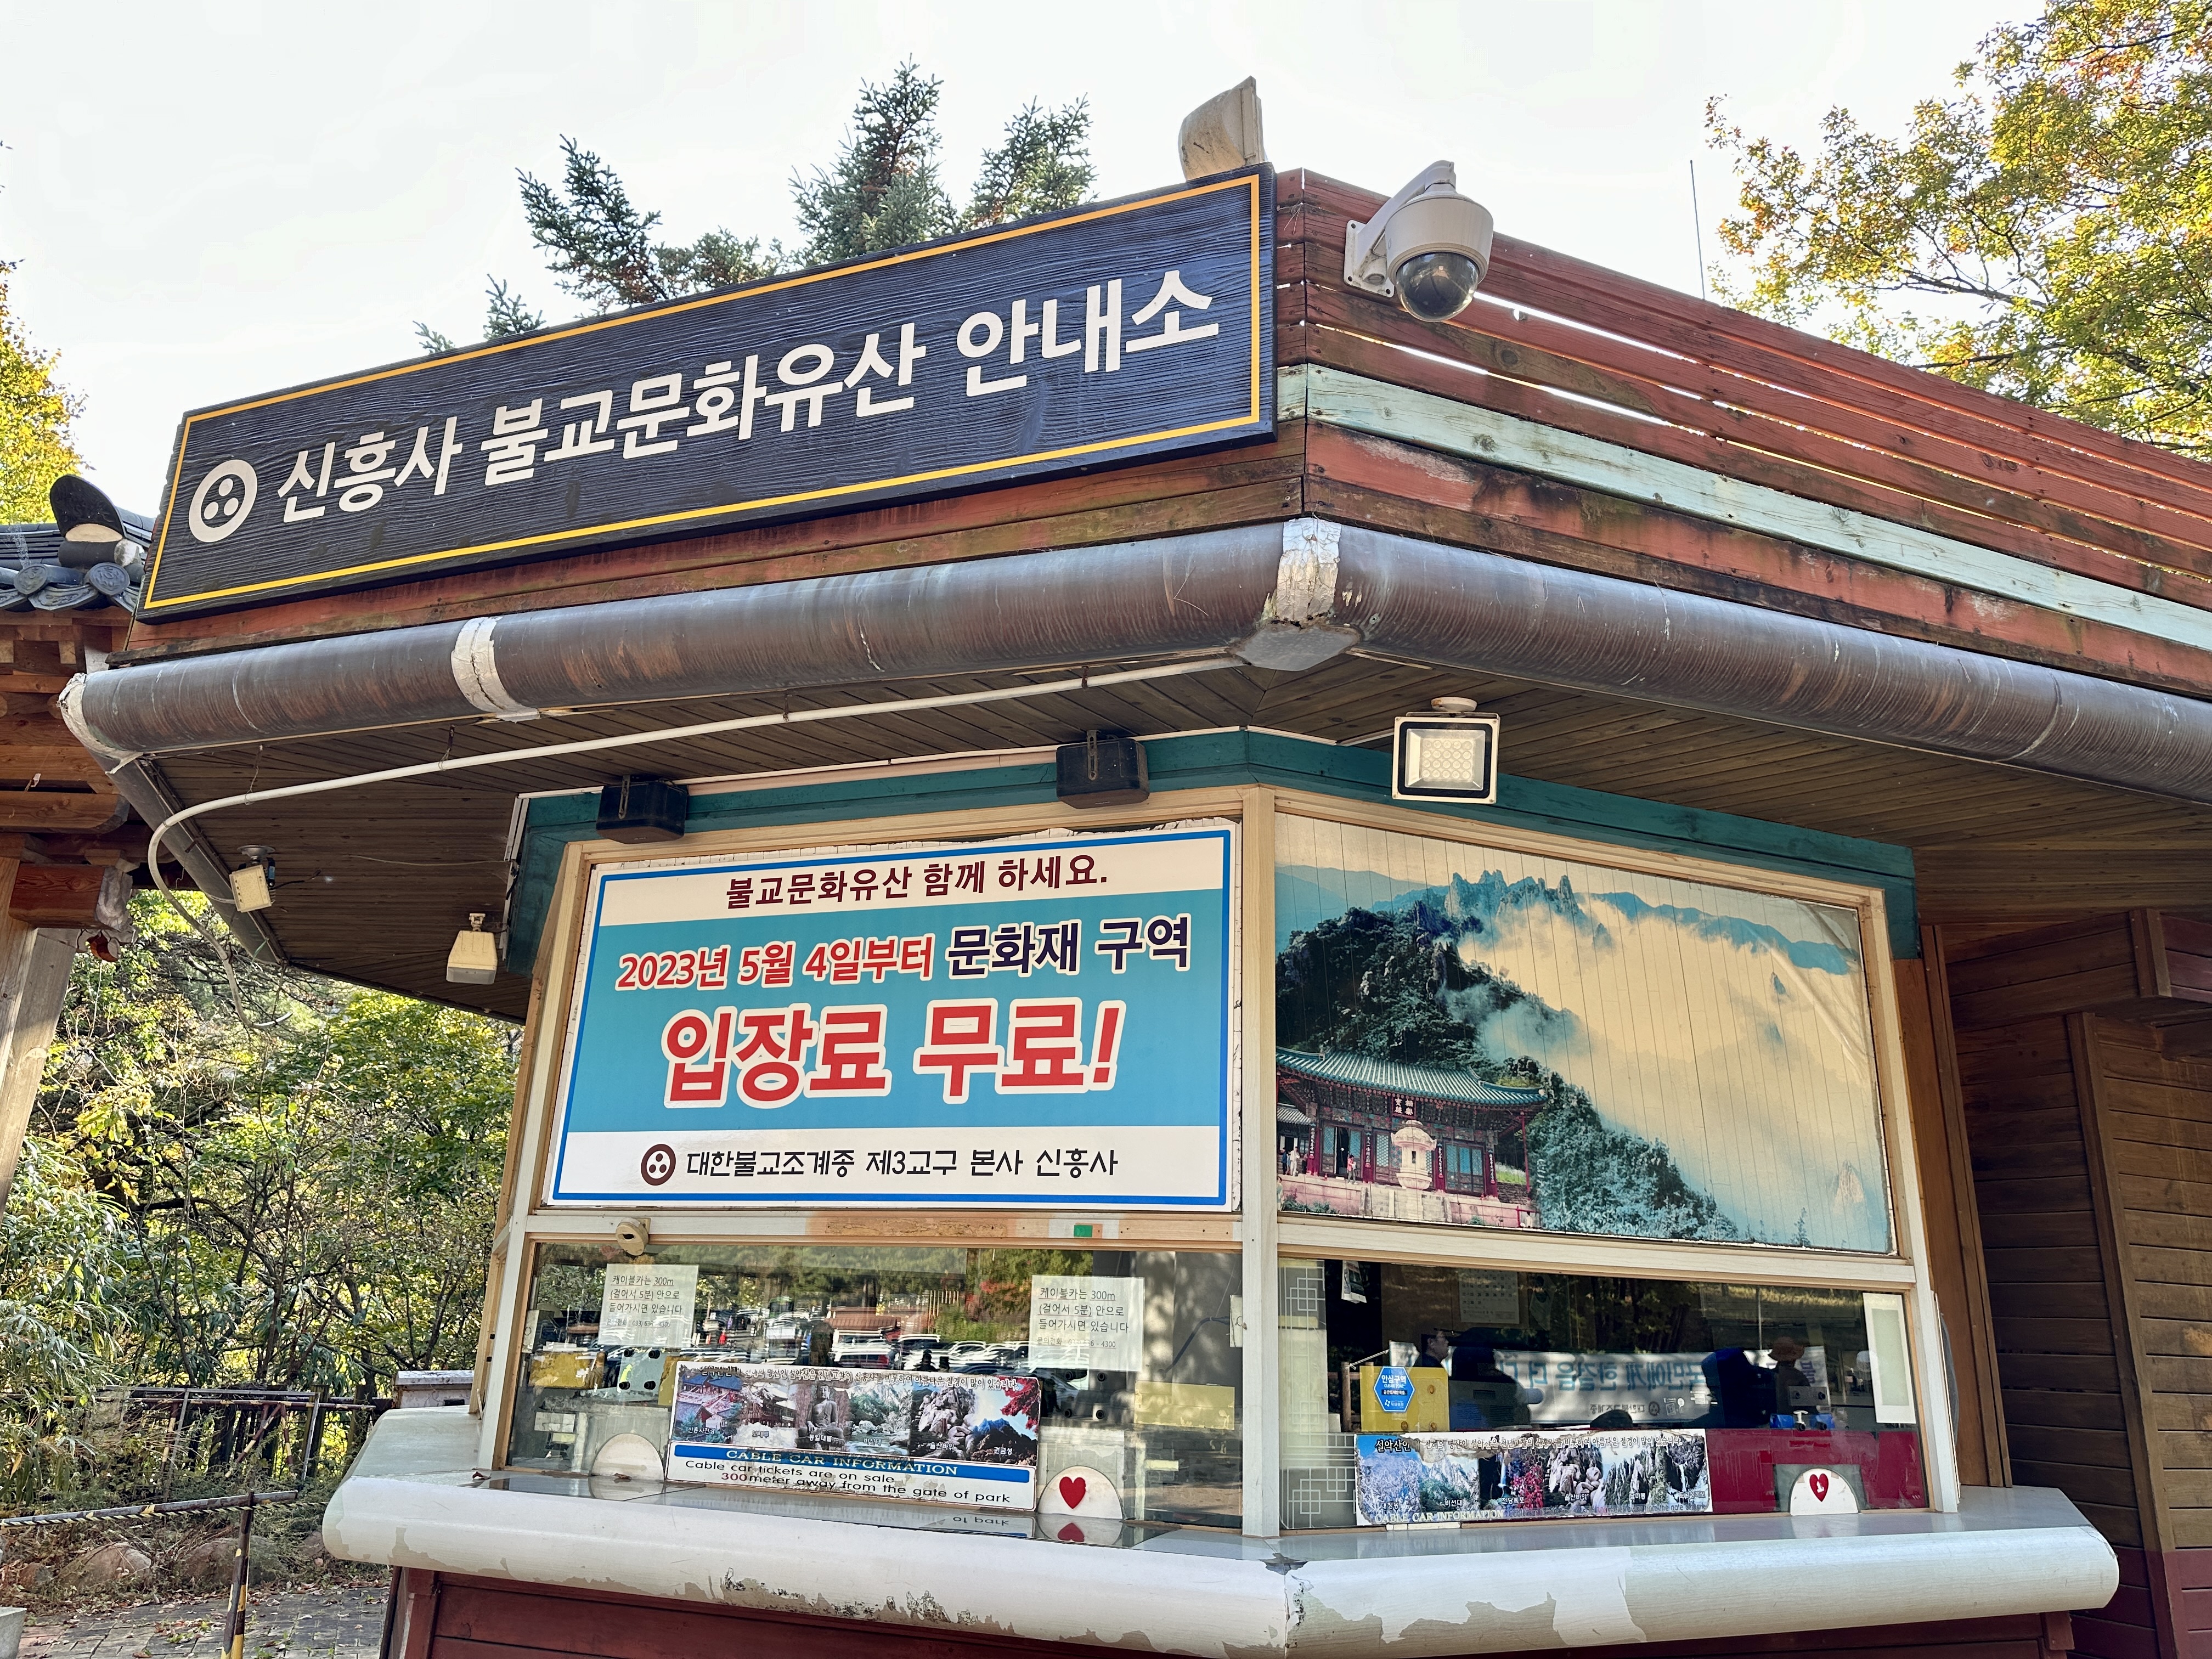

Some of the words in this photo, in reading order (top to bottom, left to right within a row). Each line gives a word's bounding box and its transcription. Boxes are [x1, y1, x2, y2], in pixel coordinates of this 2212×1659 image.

[277, 416, 462, 523] 신흥사
[481, 323, 926, 486] 불교문화유산
[957, 269, 1219, 397] 안내소
[726, 866, 912, 910] 불교문화유산
[923, 861, 985, 897] 함께
[998, 854, 1108, 891] 하세요.
[616, 945, 731, 990] 2023년
[740, 943, 794, 986] 5월
[805, 936, 932, 983] 4일부터
[947, 922, 1080, 977] 문화재
[1097, 916, 1188, 969] 구역
[666, 1009, 887, 1102] 입장료
[918, 1003, 1120, 1097] 무료!
[686, 1149, 855, 1178] 대한불교조계종
[866, 1149, 957, 1176] 제3교구
[970, 1149, 1024, 1176] 본사
[1036, 1148, 1119, 1179] 신흥사
[611, 1275, 652, 1285] 케이블카는
[654, 1277, 674, 1285] 300m
[610, 1289, 636, 1299] (걸어서
[639, 1290, 654, 1300] 5분)
[657, 1290, 680, 1299] 안으로
[1040, 1287, 1087, 1300] 케이블카는
[1091, 1290, 1115, 1300] 300m
[608, 1302, 648, 1313] 들어가시면
[651, 1304, 682, 1314] 있습니다
[1039, 1303, 1070, 1315] (걸어서
[1074, 1305, 1092, 1317] 5분)
[1096, 1305, 1124, 1316] 안으로
[1039, 1318, 1086, 1331] 들어가시면
[1037, 1336, 1063, 1345] 문의전화
[1381, 1375, 1407, 1384] 안심구역
[1592, 1436, 1620, 1448] 아름다운
[1621, 1436, 1640, 1448] 절경이
[1641, 1436, 1654, 1447] 많이
[726, 1450, 781, 1462] CABLE
[789, 1454, 825, 1465] CAR
[833, 1457, 958, 1475] INFORMATION
[685, 1460, 725, 1470] Cable
[759, 1465, 803, 1476] tickets
[864, 1474, 895, 1483] sale
[796, 1479, 836, 1489] away
[842, 1482, 876, 1492] from
[883, 1484, 906, 1493] the
[913, 1487, 947, 1497] gate
[953, 1491, 969, 1499] of
[975, 1493, 1011, 1503] park
[1444, 1498, 1463, 1508] 비선대
[1375, 1513, 1408, 1523] CABLE
[1412, 1513, 1434, 1522] CAR
[1436, 1509, 1505, 1521] INFORMATION
